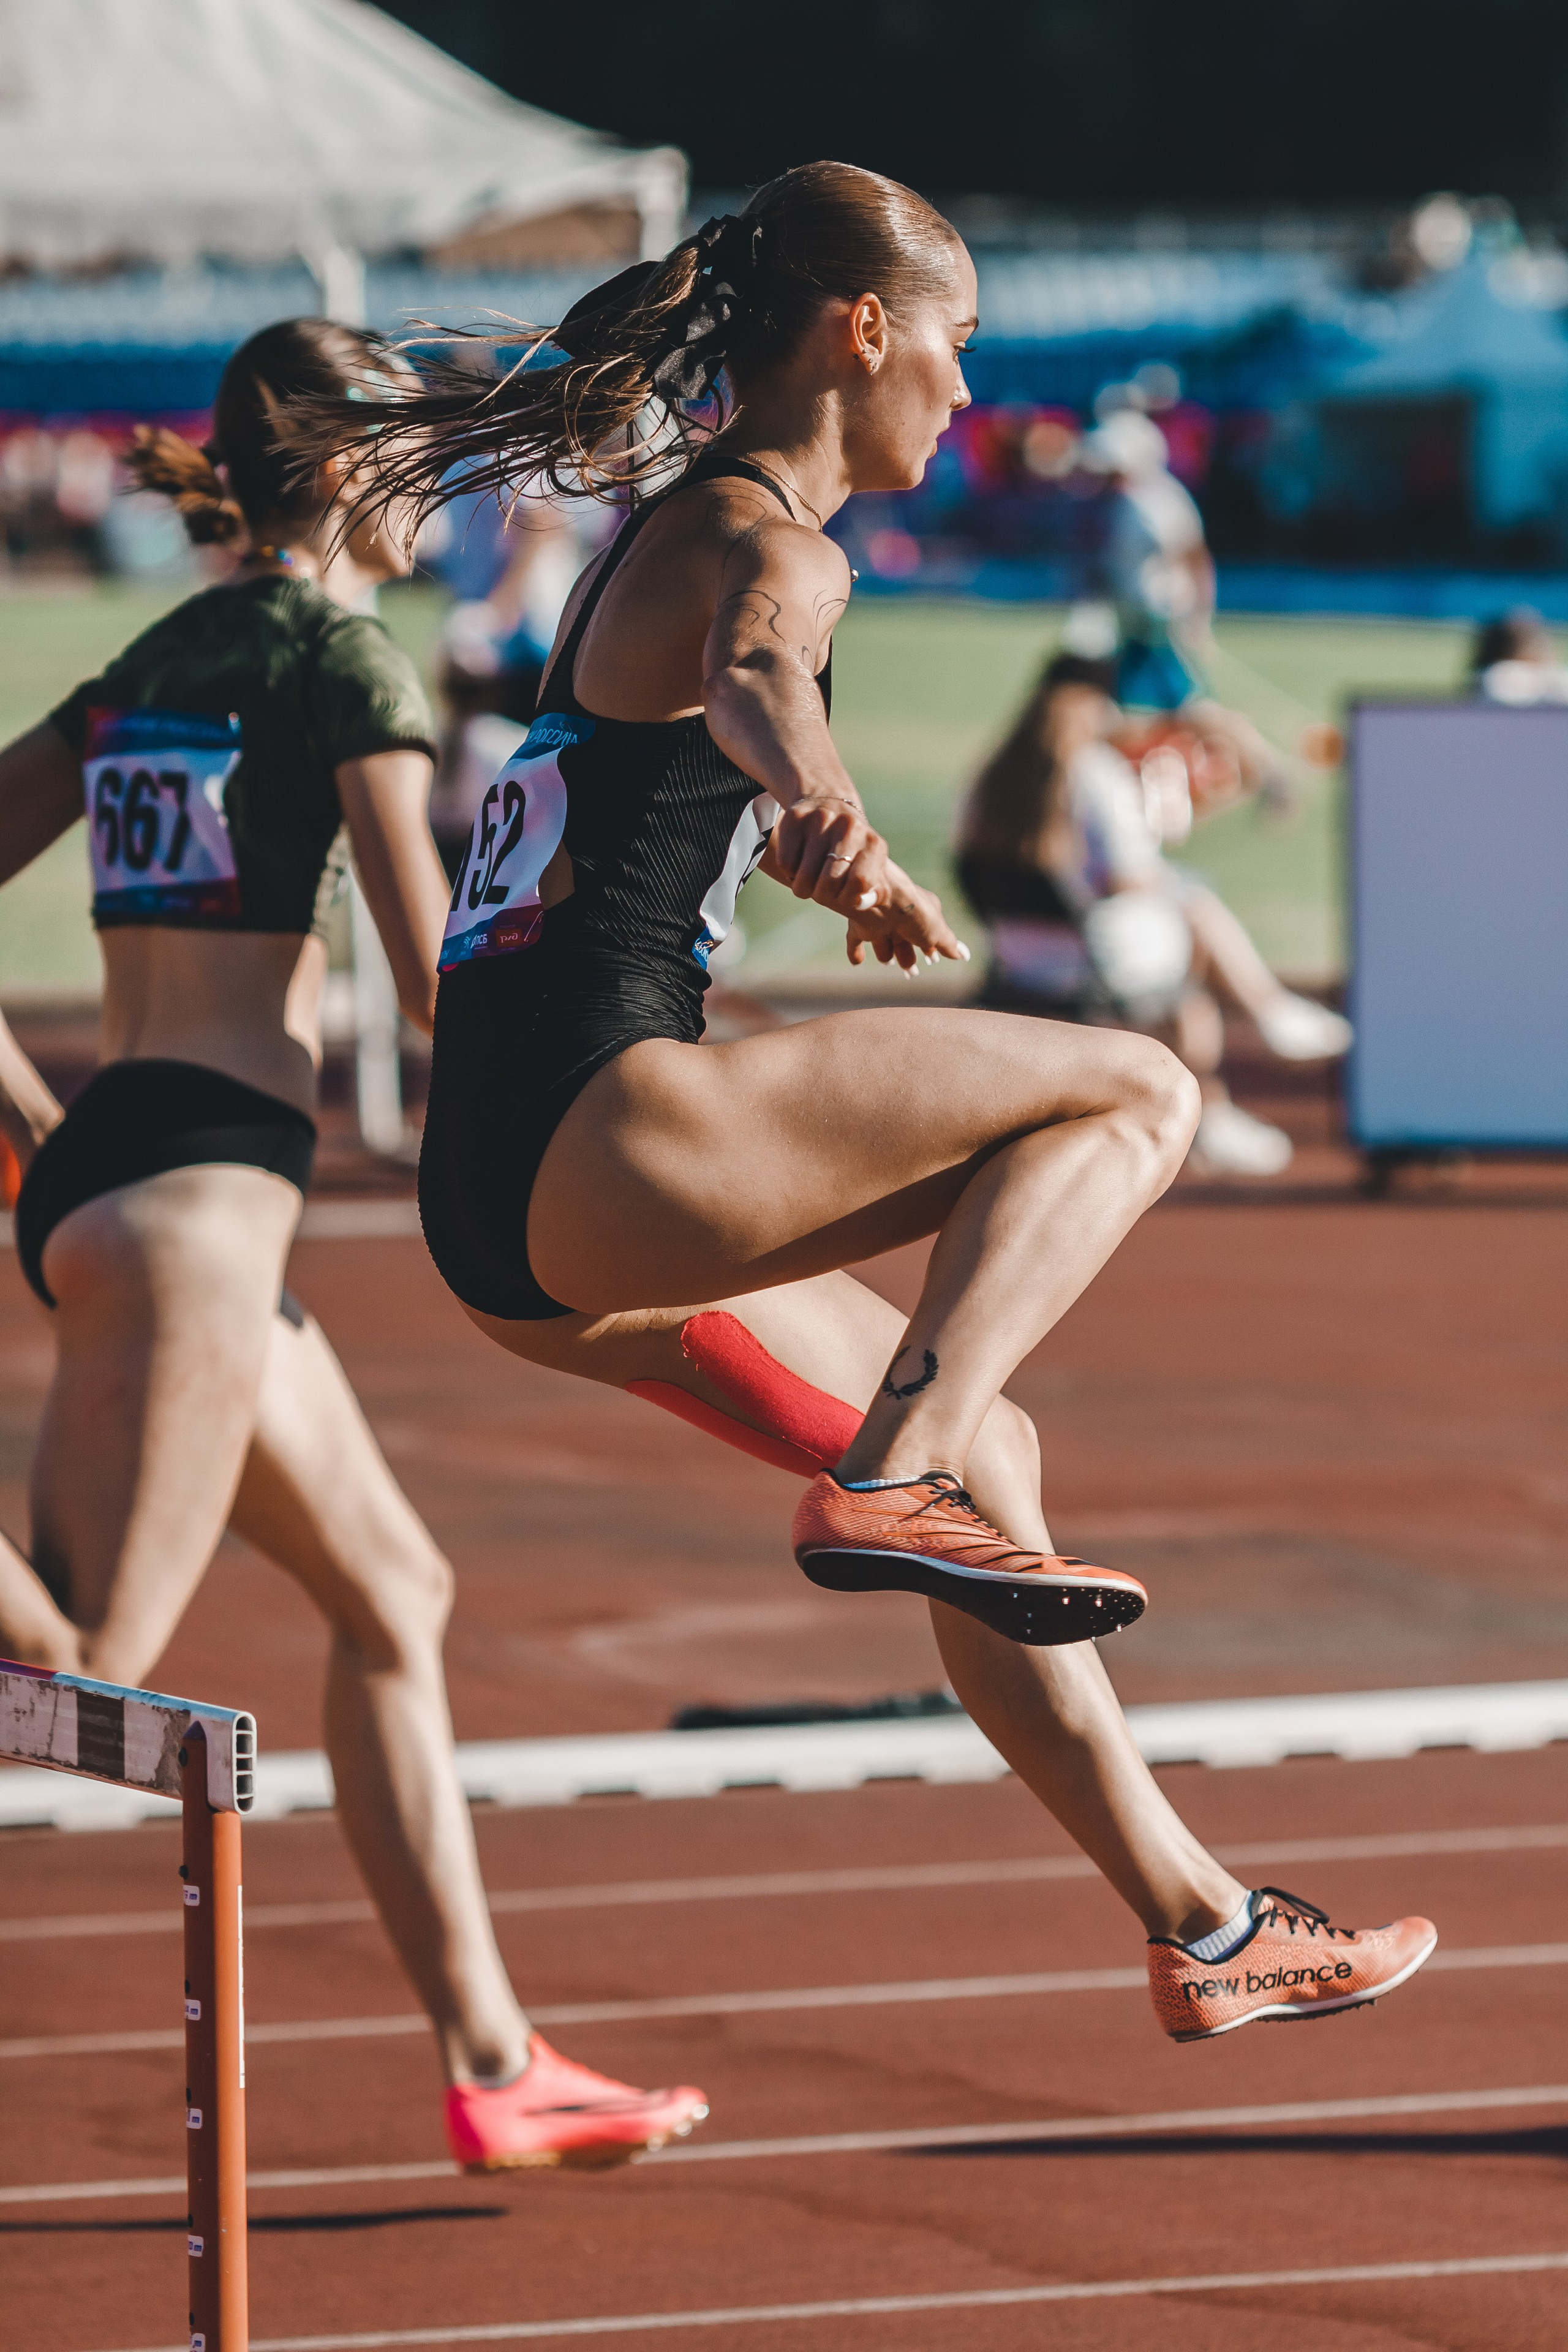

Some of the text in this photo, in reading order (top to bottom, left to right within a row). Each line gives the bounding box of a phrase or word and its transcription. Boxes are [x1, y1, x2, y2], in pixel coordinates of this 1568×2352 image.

[96, 768, 187, 871] 667
[1182, 1962, 1352, 2001] new balance
